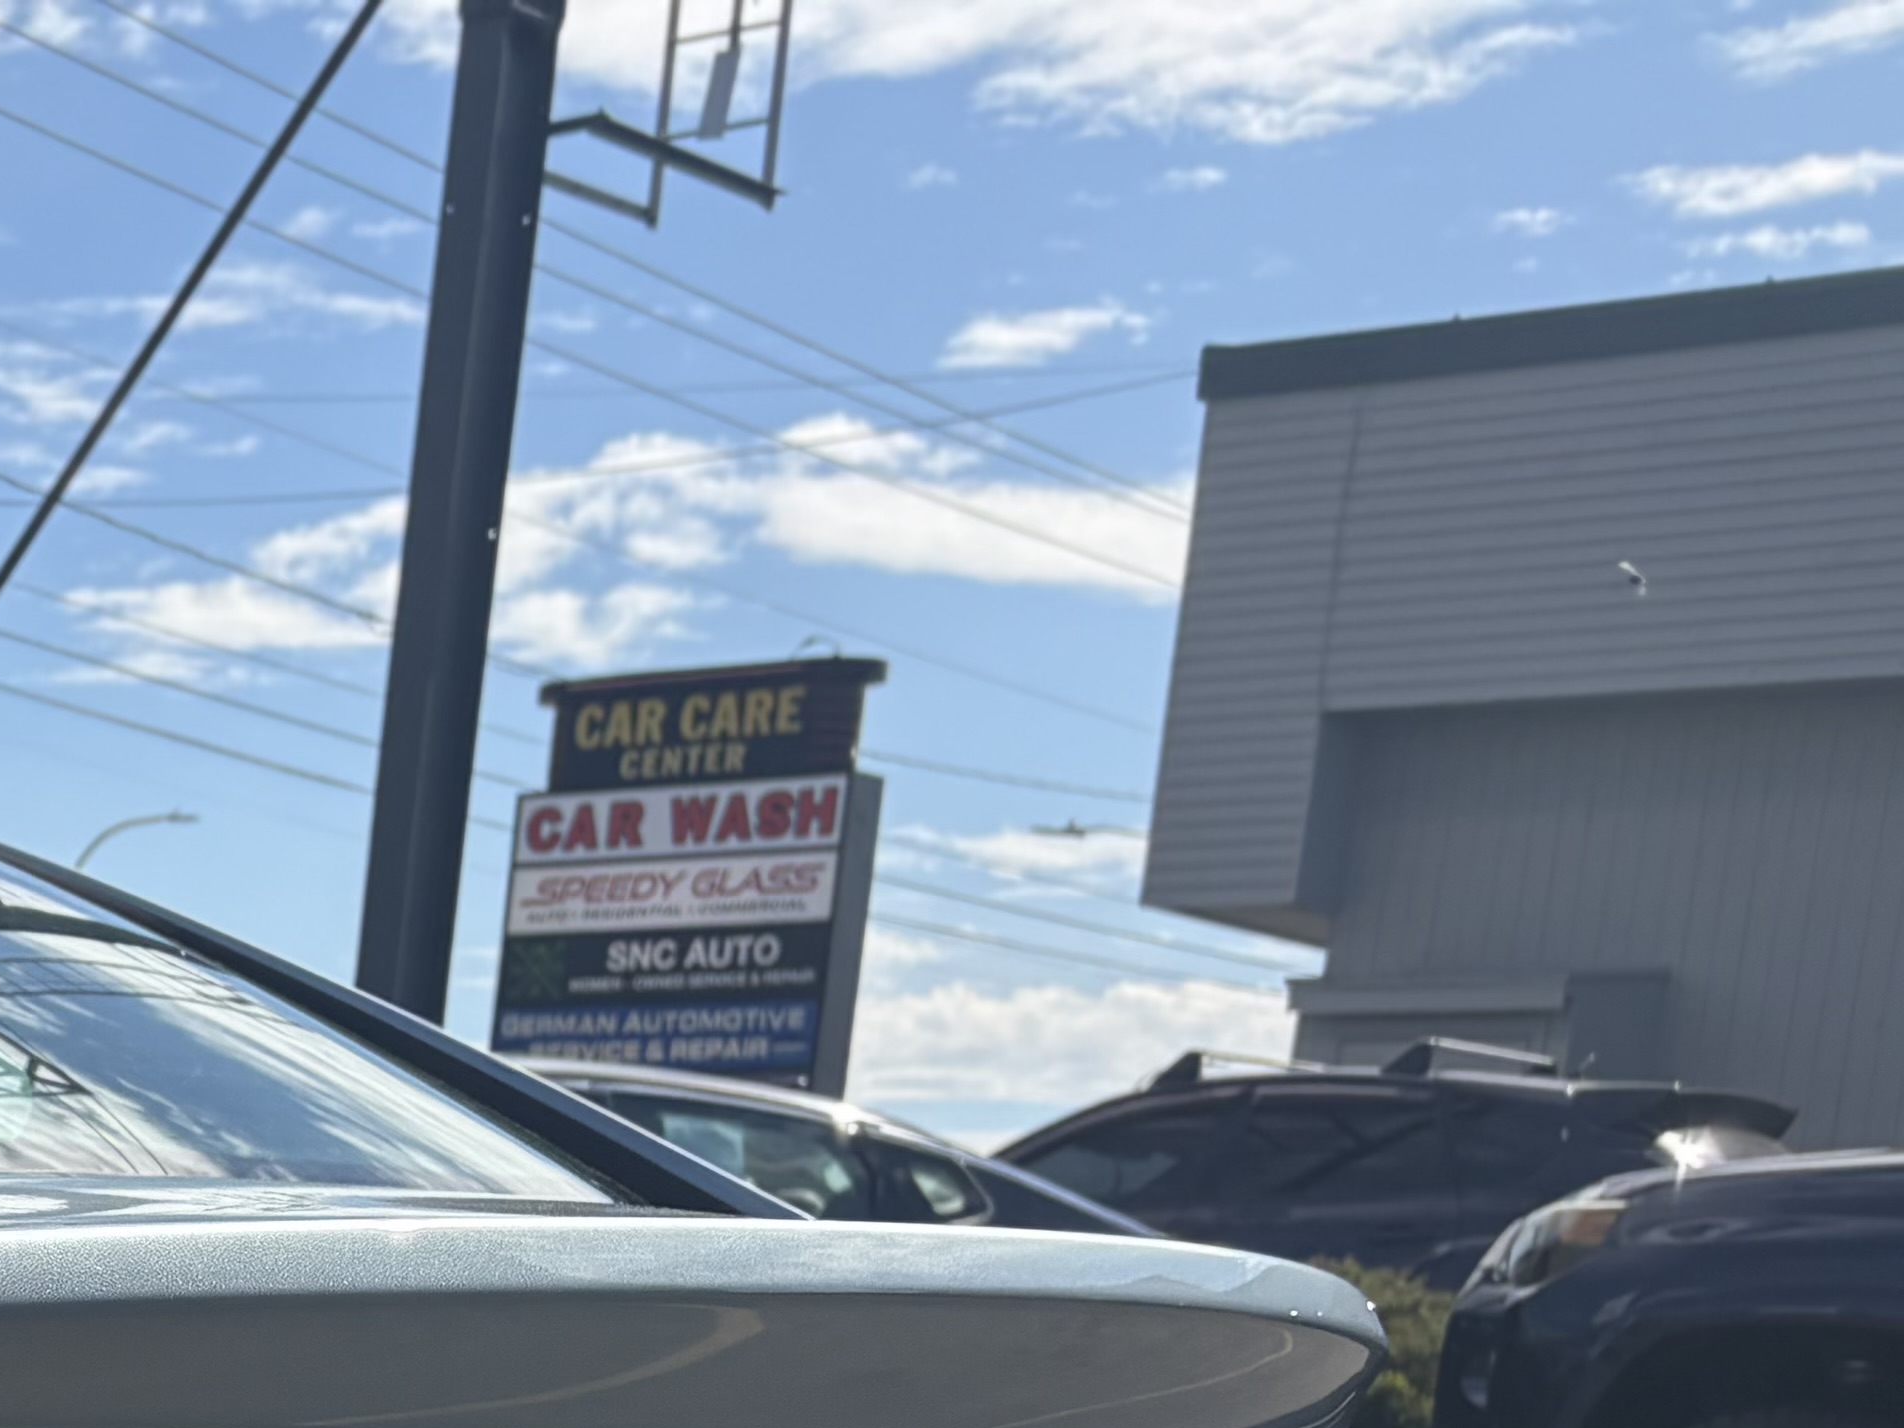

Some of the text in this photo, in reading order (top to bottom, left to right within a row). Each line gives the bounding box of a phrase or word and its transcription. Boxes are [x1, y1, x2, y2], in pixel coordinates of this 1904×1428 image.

[574, 687, 807, 750] CAR CARE
[619, 743, 748, 781] CENTER
[526, 786, 840, 855] CAR WASH
[520, 862, 828, 907] SPEEDY GLASS
[606, 933, 781, 974] SNC AUTO
[500, 1006, 805, 1038] GERMAN AUTOMOTIVE
[645, 1039, 665, 1062] &
[669, 1036, 769, 1061] REPAIR
